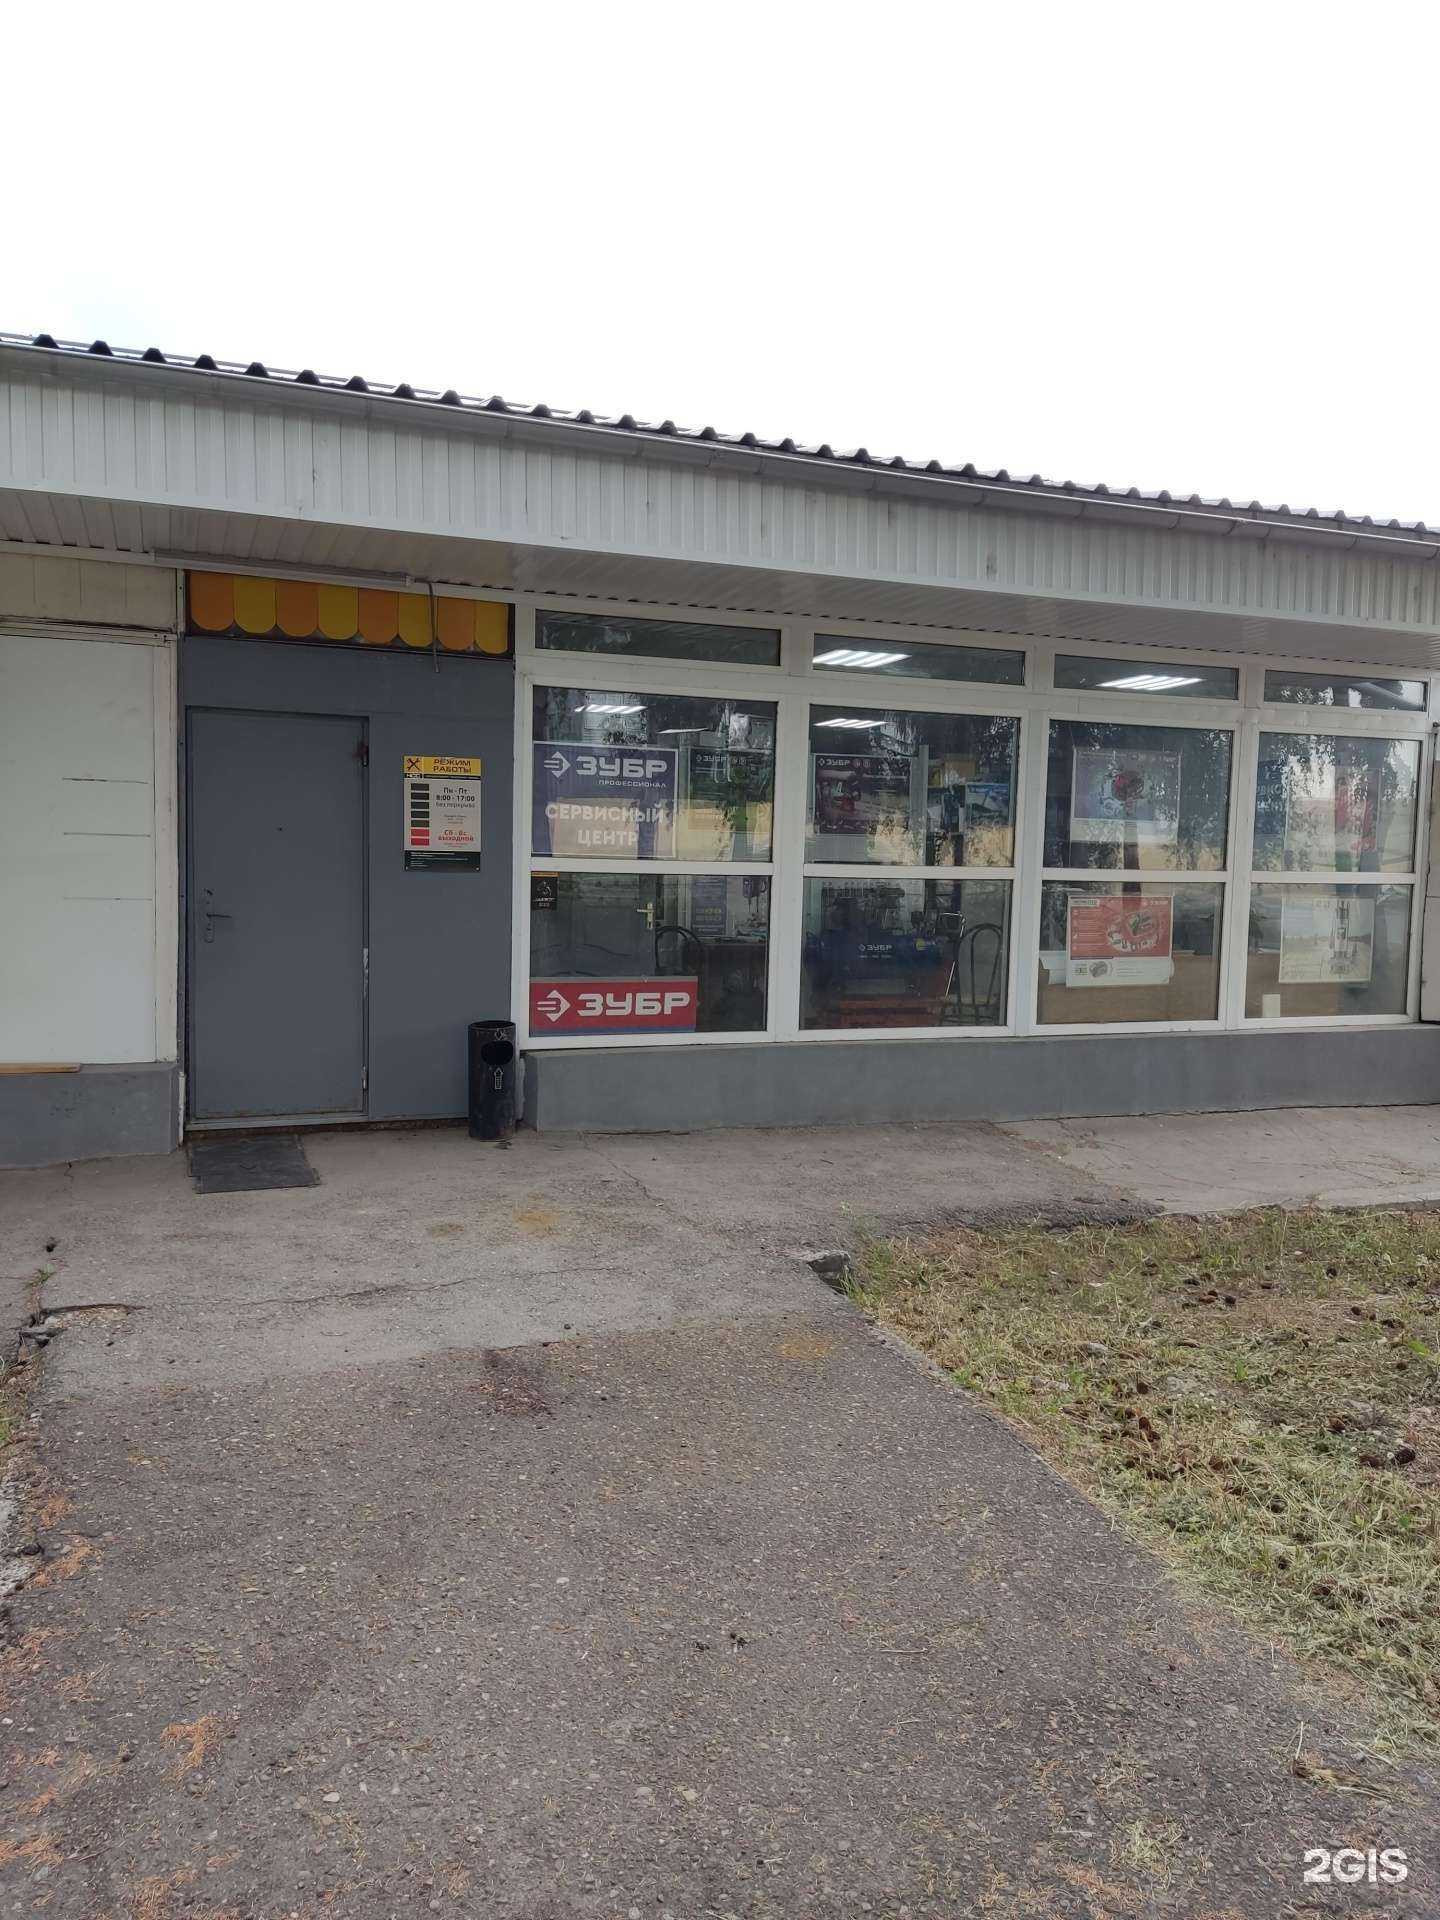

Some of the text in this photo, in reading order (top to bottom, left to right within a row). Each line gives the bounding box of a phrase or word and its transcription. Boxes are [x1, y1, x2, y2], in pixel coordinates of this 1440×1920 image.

[433, 758, 471, 767] РЕЖИМ
[576, 755, 667, 778] ЗУБР
[826, 759, 850, 767] ЗУБР
[433, 765, 471, 773] РАБОТЫ
[598, 779, 667, 788] ПРОФЕССИОНАЛ
[458, 787, 468, 795] Пт
[545, 802, 666, 824] СЕРВИСНЫЙ
[577, 829, 639, 848] ЦЕНТР
[576, 991, 690, 1016] ЗУБР
